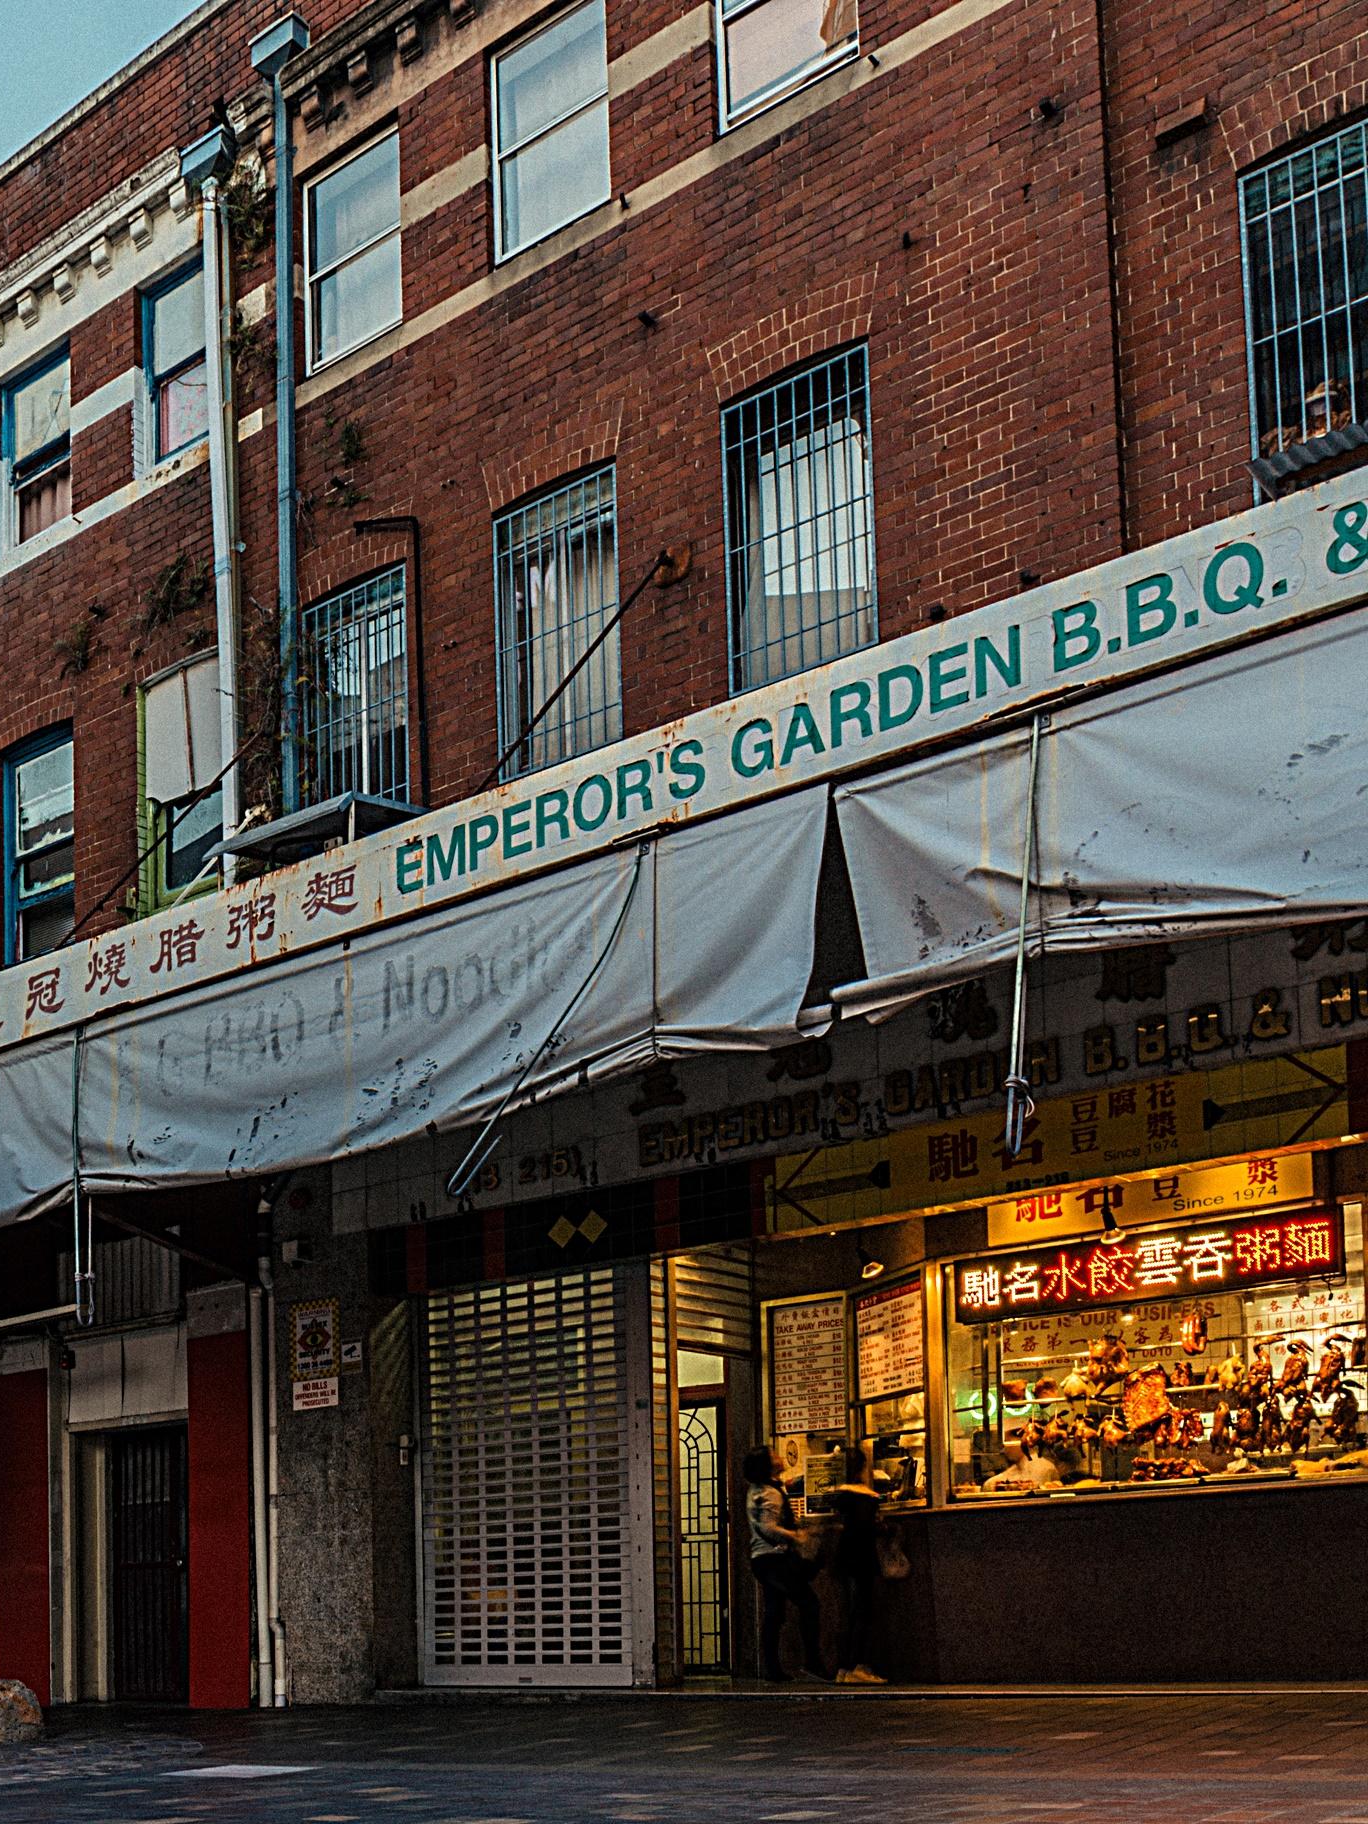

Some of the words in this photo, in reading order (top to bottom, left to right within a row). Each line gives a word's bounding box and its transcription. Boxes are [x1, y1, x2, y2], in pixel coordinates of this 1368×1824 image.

[395, 738, 706, 895] EMPEROR'S
[730, 622, 1023, 779] GARDEN
[1052, 541, 1289, 673] B.B.Q.
[1325, 500, 1368, 575] &
[927, 1115, 1044, 1183] 馳名
[1104, 1147, 1140, 1162] Since
[1146, 1138, 1179, 1155] 1974
[1173, 1194, 1224, 1212] Since
[1232, 1185, 1279, 1202] 1974
[775, 1325, 794, 1334] TAKE
[796, 1322, 816, 1332] AWAY
[818, 1318, 845, 1329] PRICES
[1081, 1311, 1118, 1327] OUR
[302, 1383, 310, 1391] NO
[312, 1381, 328, 1390] BILLS
